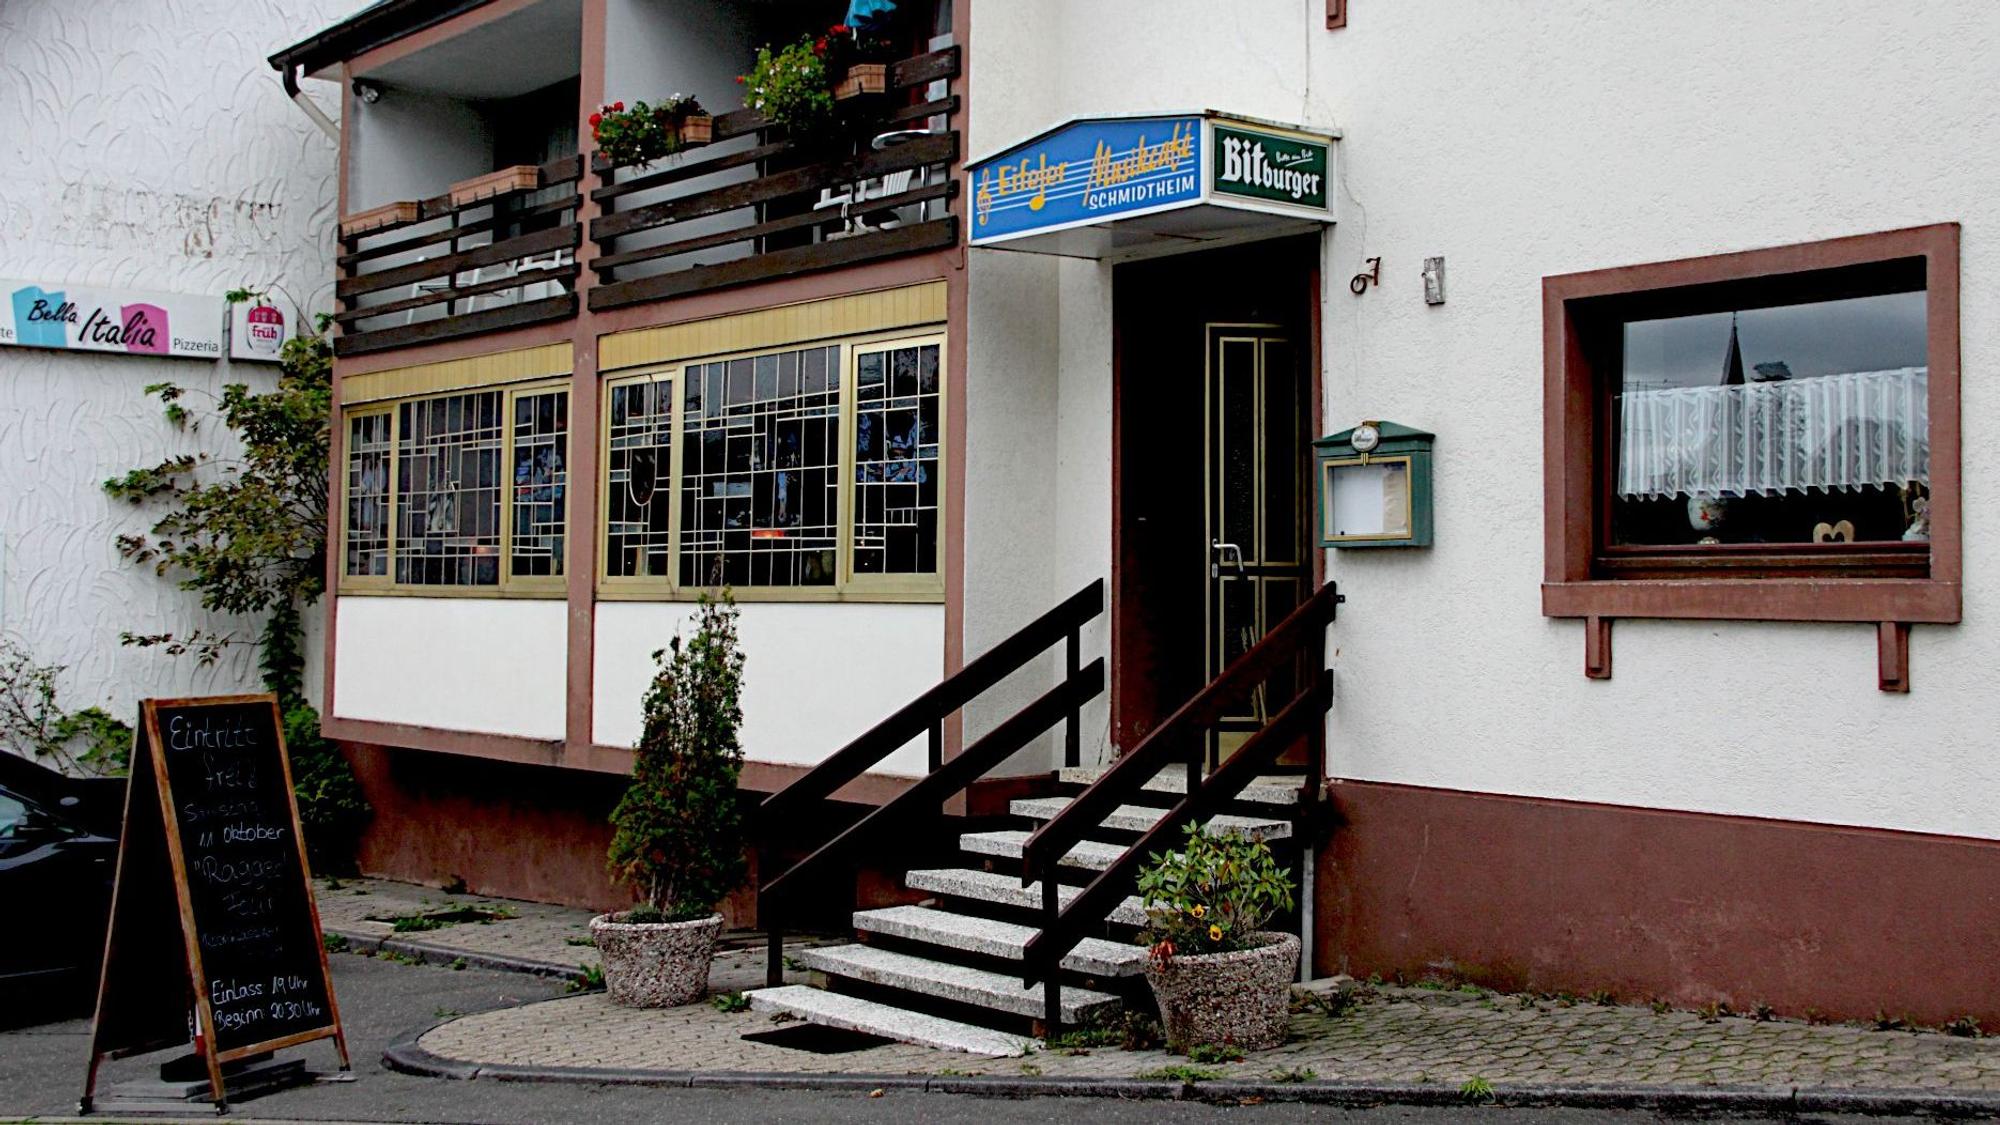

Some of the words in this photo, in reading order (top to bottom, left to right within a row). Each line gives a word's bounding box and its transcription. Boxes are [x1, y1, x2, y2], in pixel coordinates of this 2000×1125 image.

[1220, 136, 1320, 199] Bitburger
[1088, 175, 1195, 210] SCHMIDTHEIM
[28, 299, 77, 323] Bella
[78, 307, 156, 347] Italia
[173, 338, 219, 352] Pizzeria
